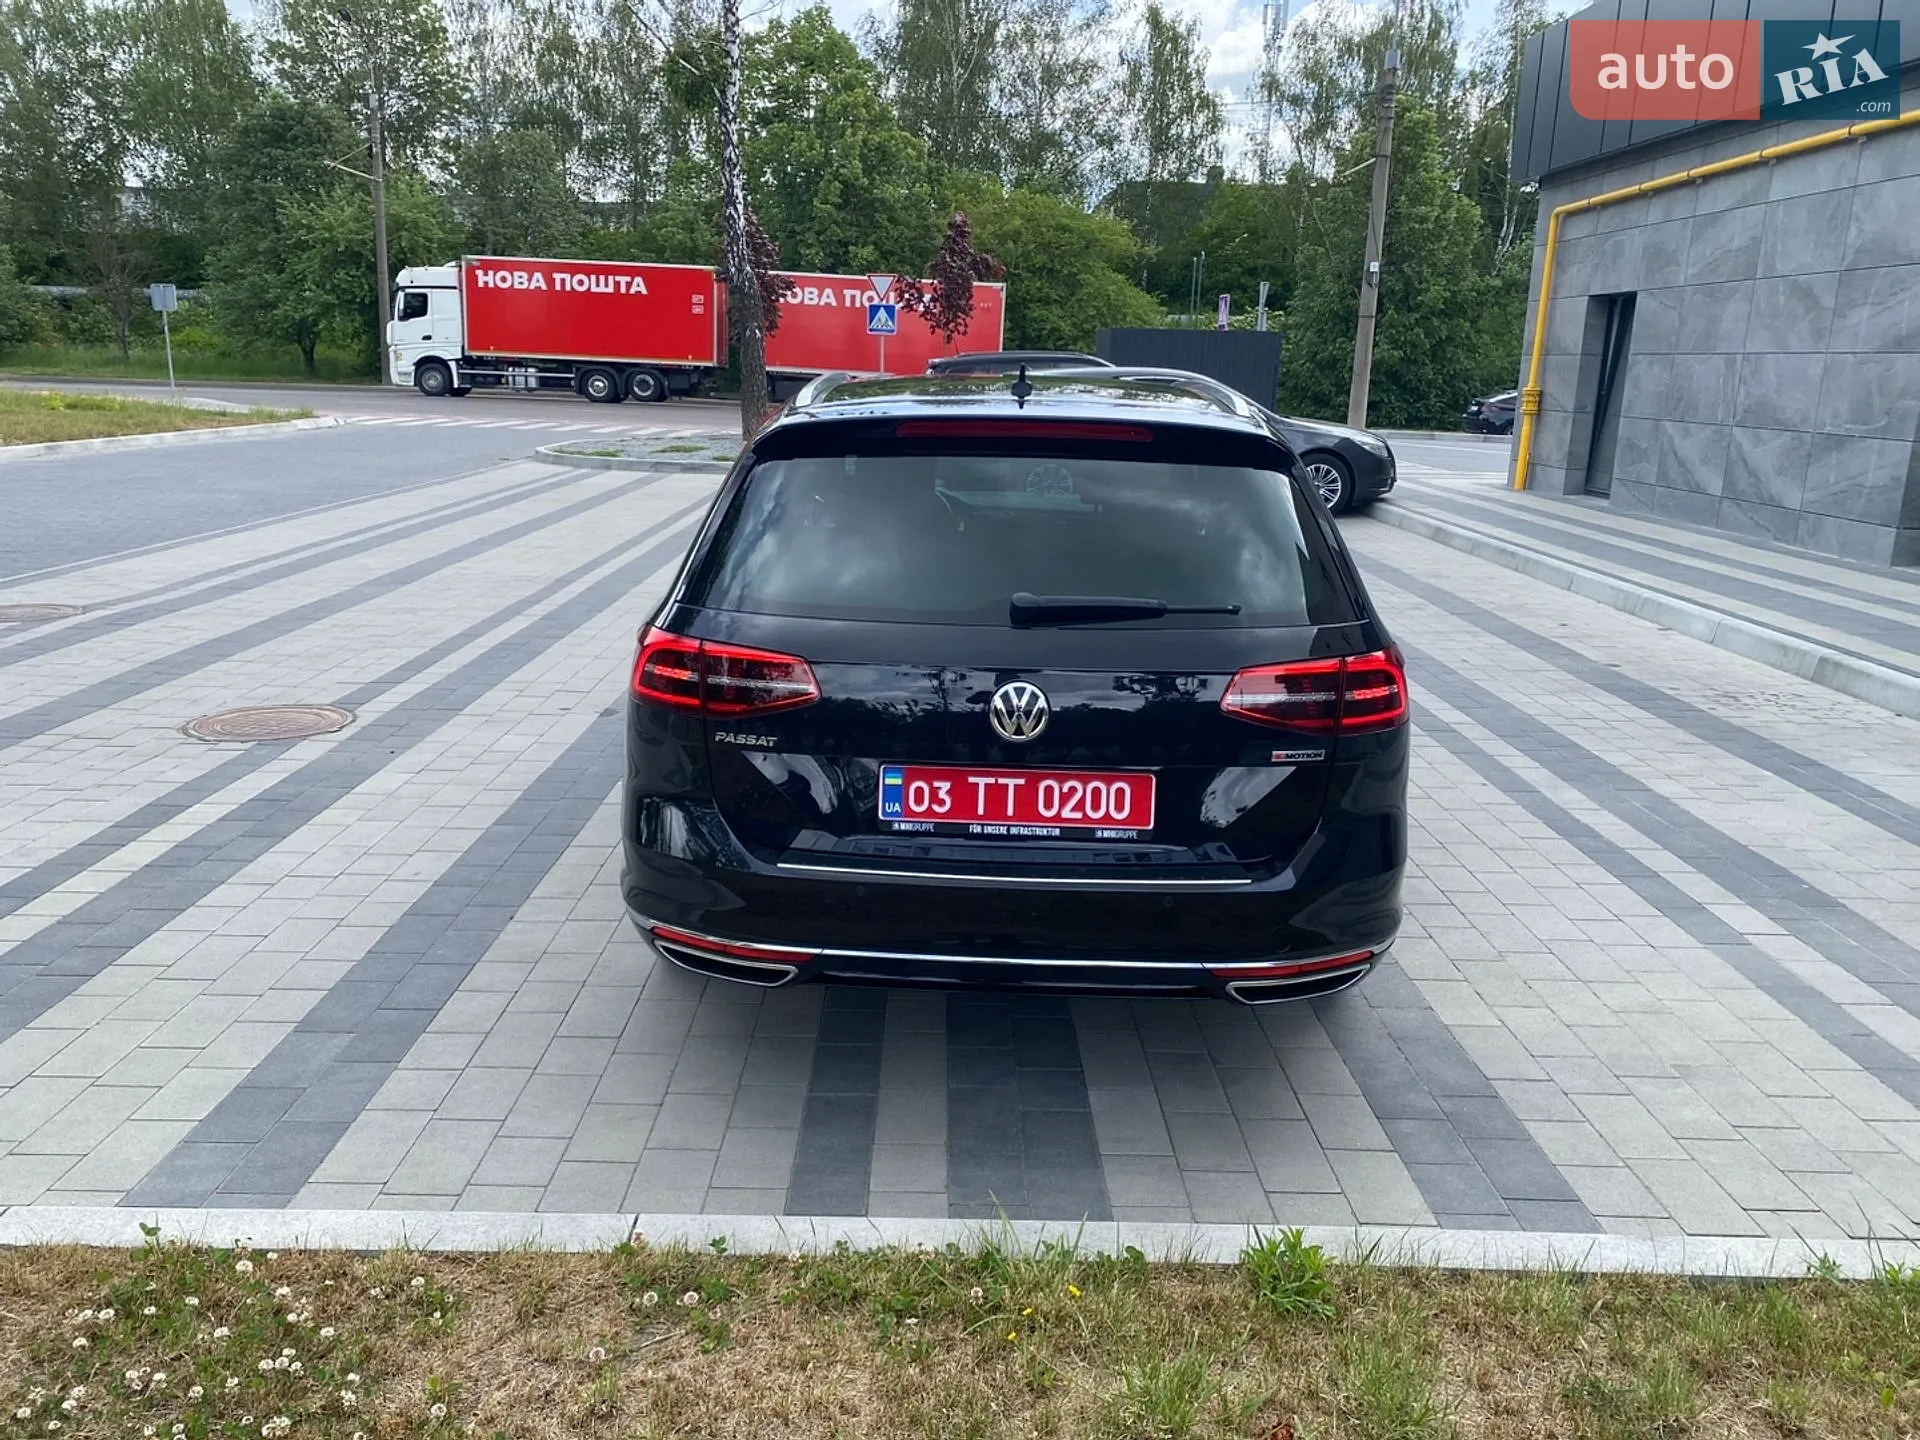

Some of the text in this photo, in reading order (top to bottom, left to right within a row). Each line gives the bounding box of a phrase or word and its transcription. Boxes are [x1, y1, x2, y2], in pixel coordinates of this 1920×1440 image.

[475, 269, 648, 295] НОВА ПОШТА
[778, 286, 837, 307] ОВА
[715, 731, 778, 747] PASSAT
[885, 802, 902, 813] UA
[908, 776, 1132, 820] 03 TT 0200
